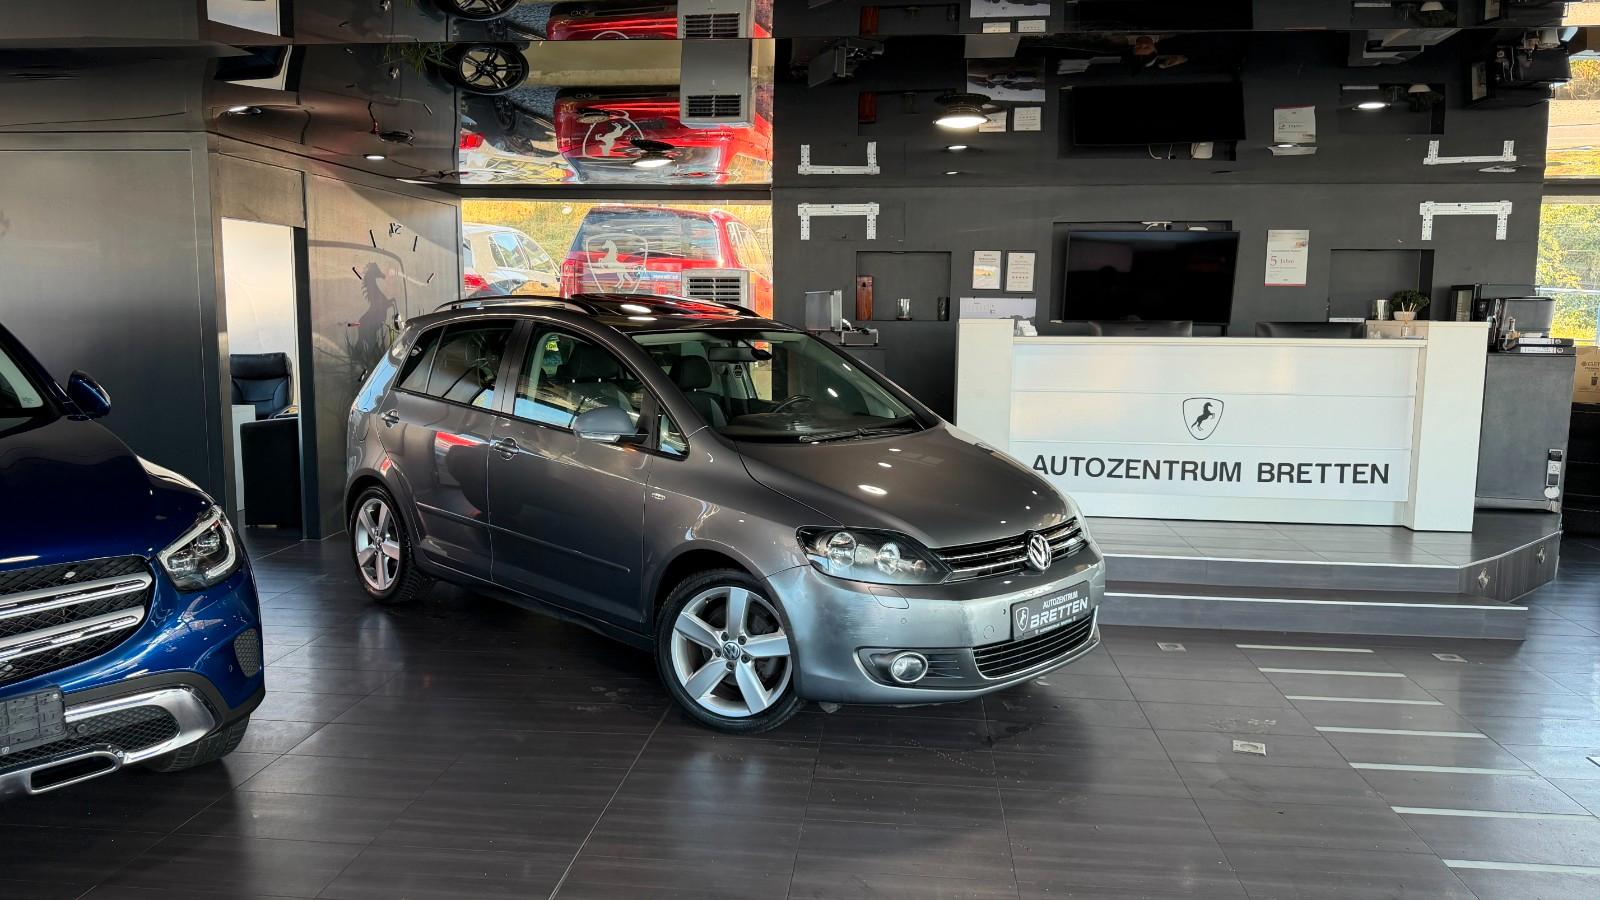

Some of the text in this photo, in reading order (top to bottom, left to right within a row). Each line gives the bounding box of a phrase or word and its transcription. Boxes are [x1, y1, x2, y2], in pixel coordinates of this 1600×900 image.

[1032, 454, 1389, 484] AUTOZENTRUM BRETTEN
[1030, 596, 1088, 628] BRETTEN
[1042, 590, 1078, 608] AUTOZENTRUM
